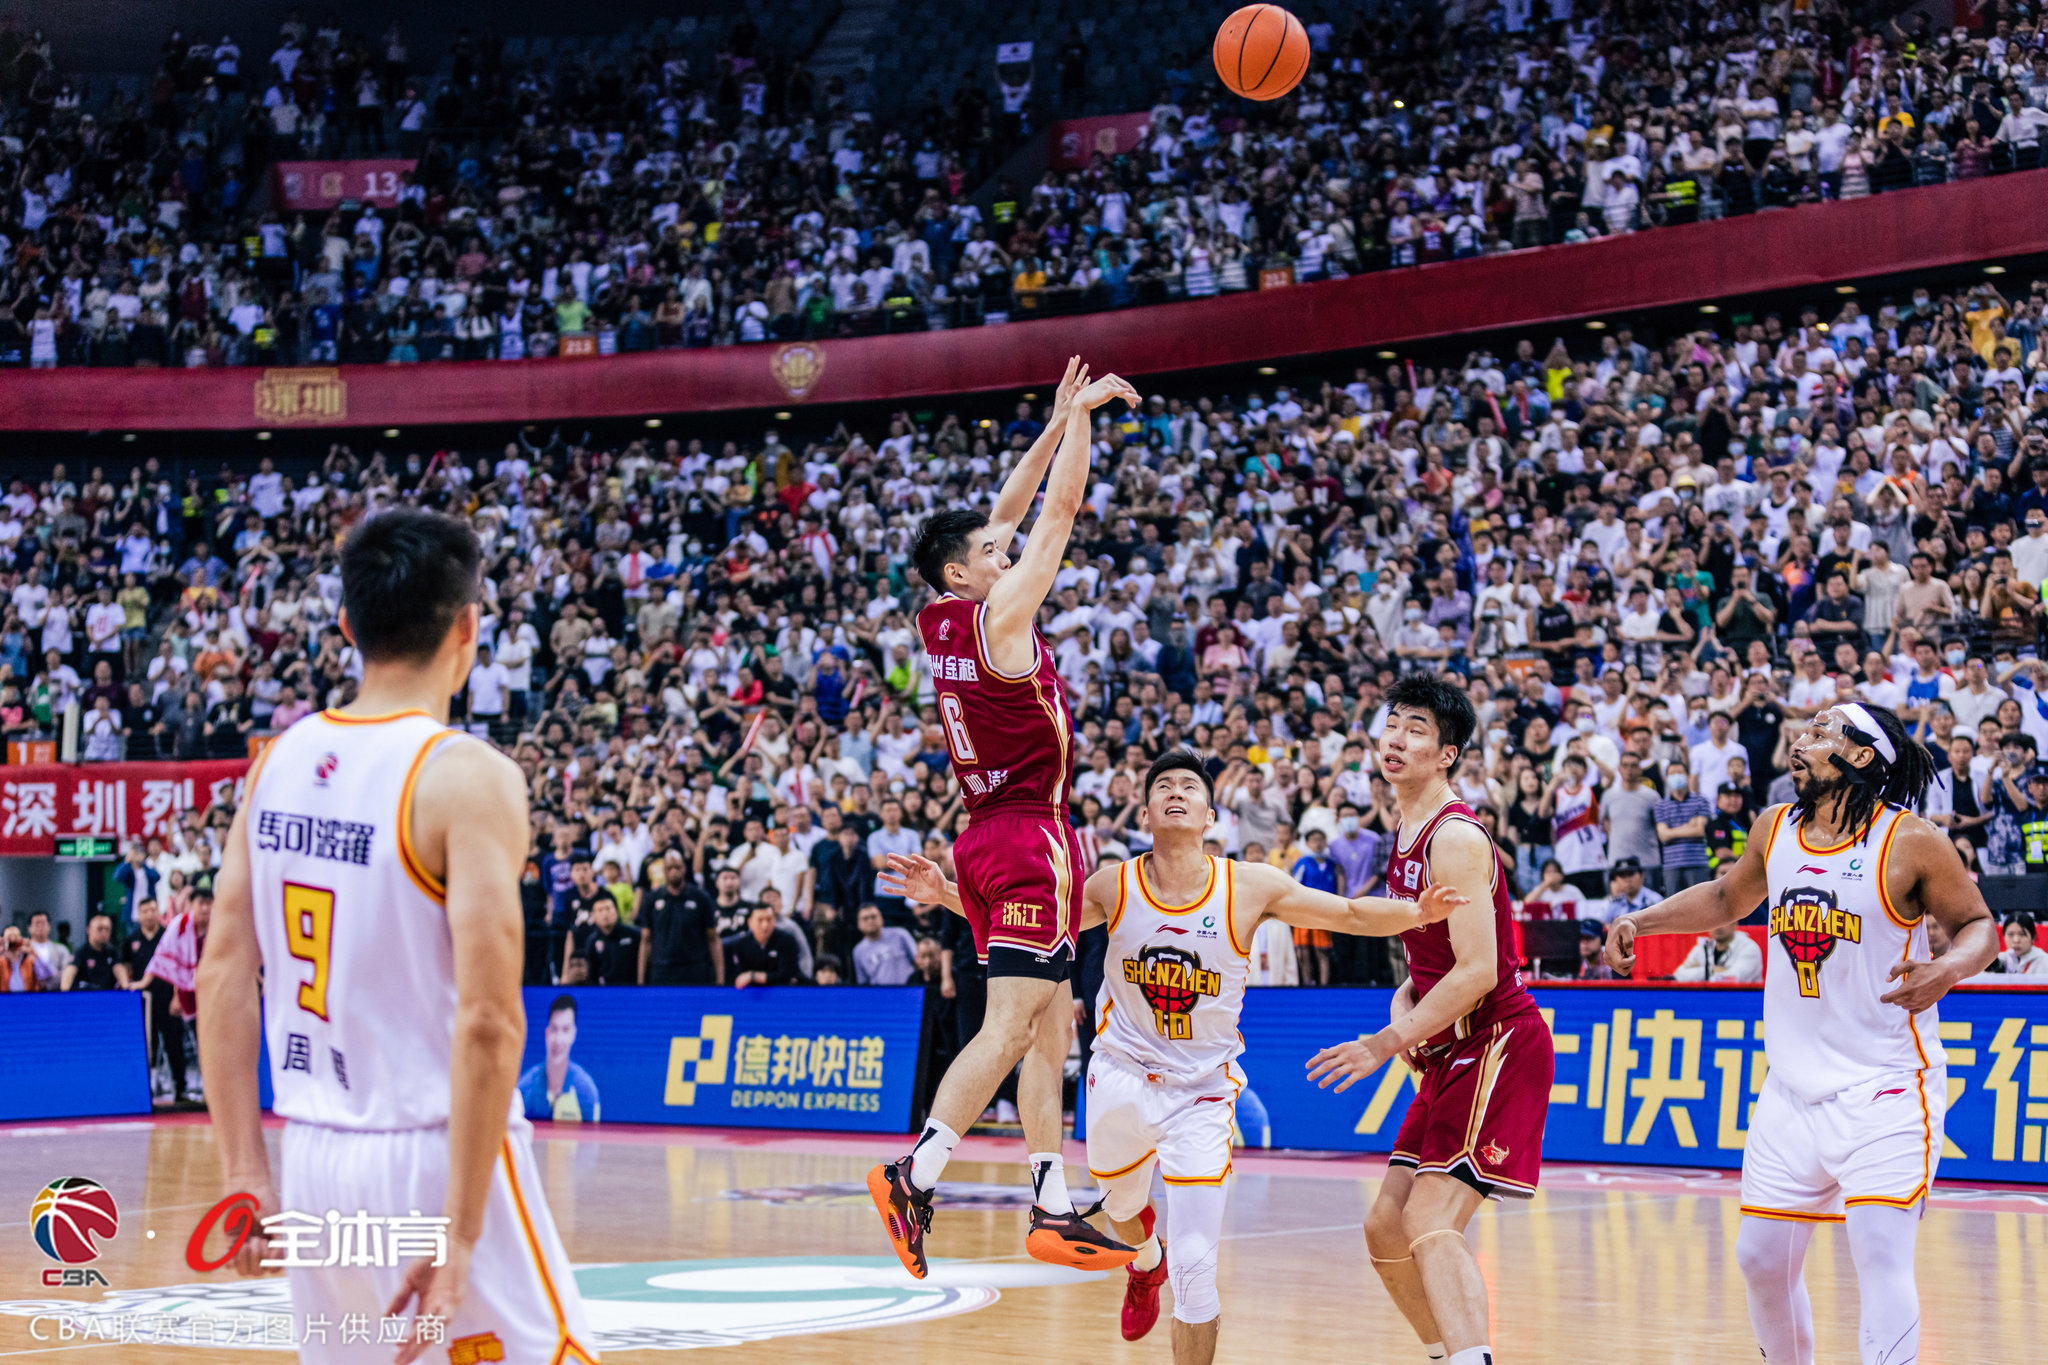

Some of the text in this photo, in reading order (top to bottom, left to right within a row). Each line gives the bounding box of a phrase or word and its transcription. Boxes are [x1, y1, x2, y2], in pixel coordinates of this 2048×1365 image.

[927, 654, 979, 682] 州金租
[940, 692, 978, 765] 6
[1002, 901, 1043, 928] 浙江
[1769, 904, 1862, 945] SHENZHEN
[283, 880, 336, 1023] 9
[1122, 958, 1222, 998] SHENZHEN
[1796, 960, 1821, 999] 0
[1152, 1007, 1194, 1041] 10
[734, 1034, 885, 1088] 德邦快递
[731, 1089, 881, 1113] DEPPON EXPRESS
